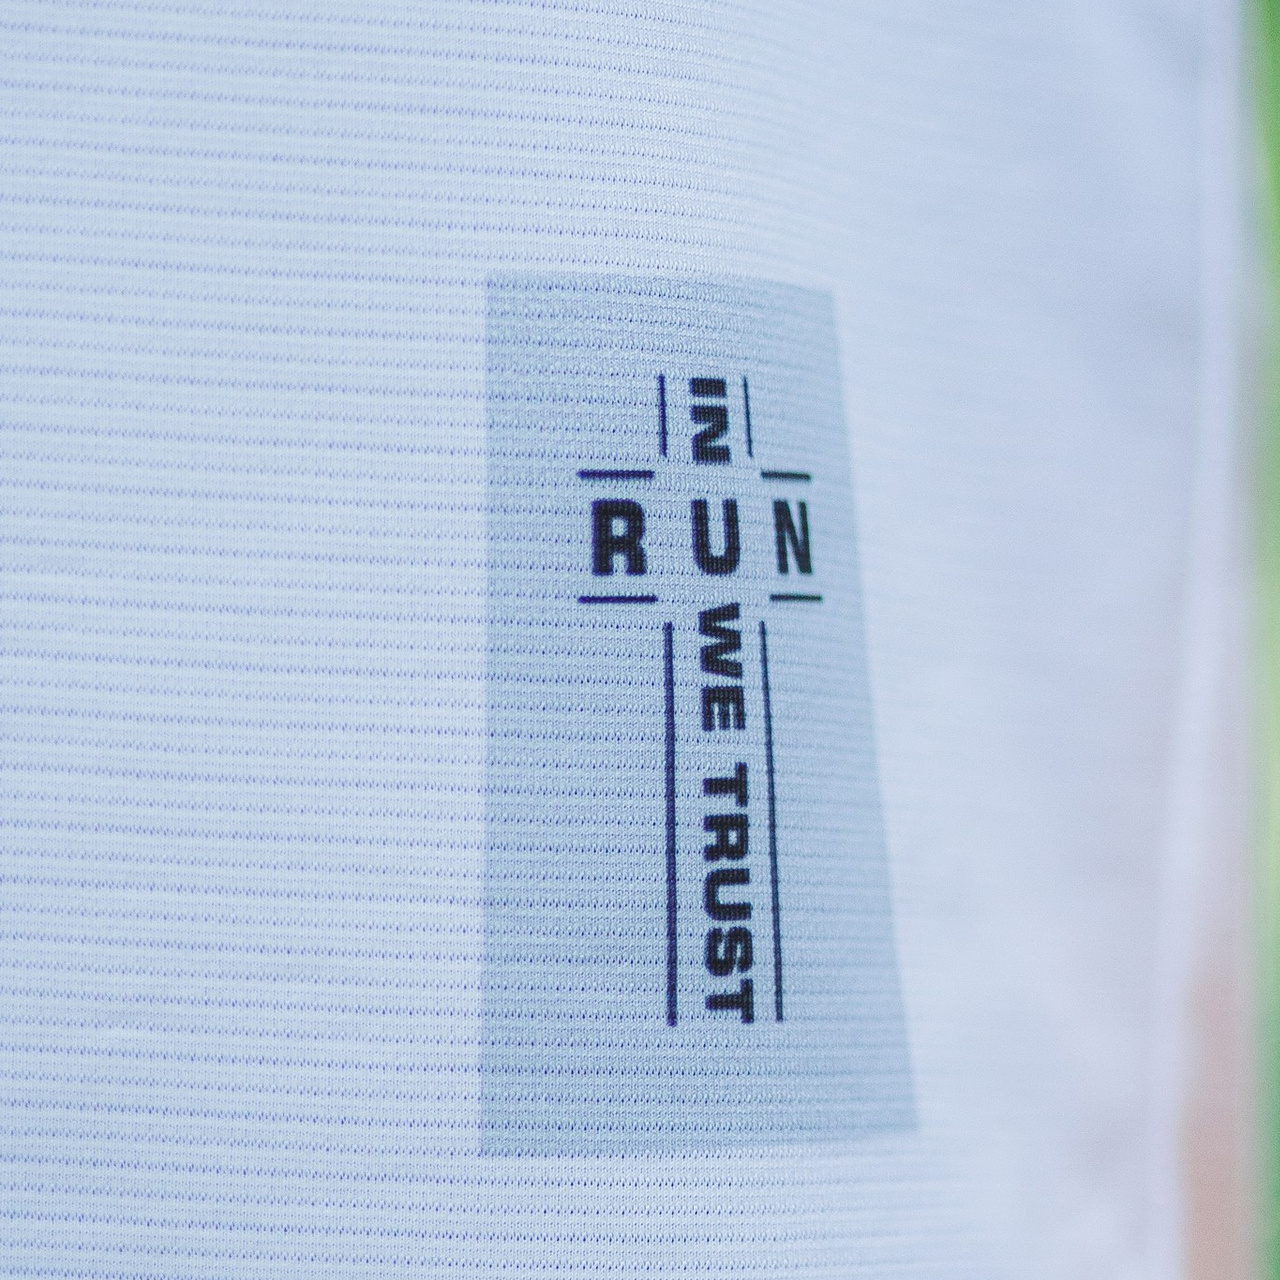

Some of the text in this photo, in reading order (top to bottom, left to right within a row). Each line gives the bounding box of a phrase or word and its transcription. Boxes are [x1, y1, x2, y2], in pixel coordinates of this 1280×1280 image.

[689, 376, 732, 464] IN
[590, 498, 814, 578] RUN
[697, 601, 756, 1024] WE TRUST
